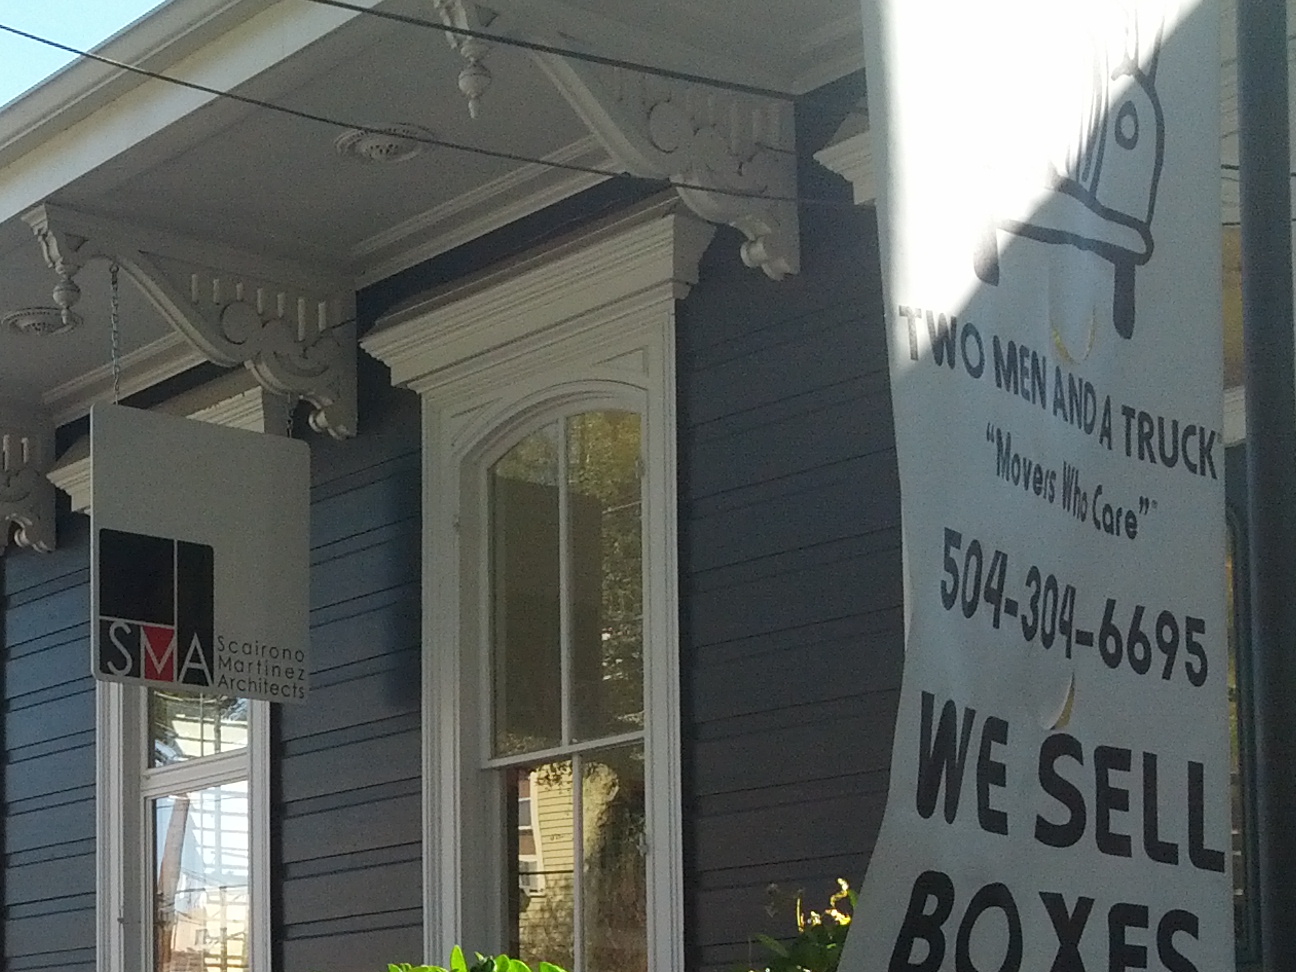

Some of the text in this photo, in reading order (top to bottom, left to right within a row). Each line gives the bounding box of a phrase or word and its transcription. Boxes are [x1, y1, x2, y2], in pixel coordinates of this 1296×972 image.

[899, 305, 1218, 480] TWO MEN AND A TRUCK
[1062, 460, 1088, 523] Who
[940, 526, 1208, 688] 504-304-6695
[106, 620, 214, 688] SMA
[217, 635, 305, 663] Scairono
[217, 655, 305, 681] Martinez
[217, 674, 305, 699] Architects
[916, 690, 1226, 873] WE SELL
